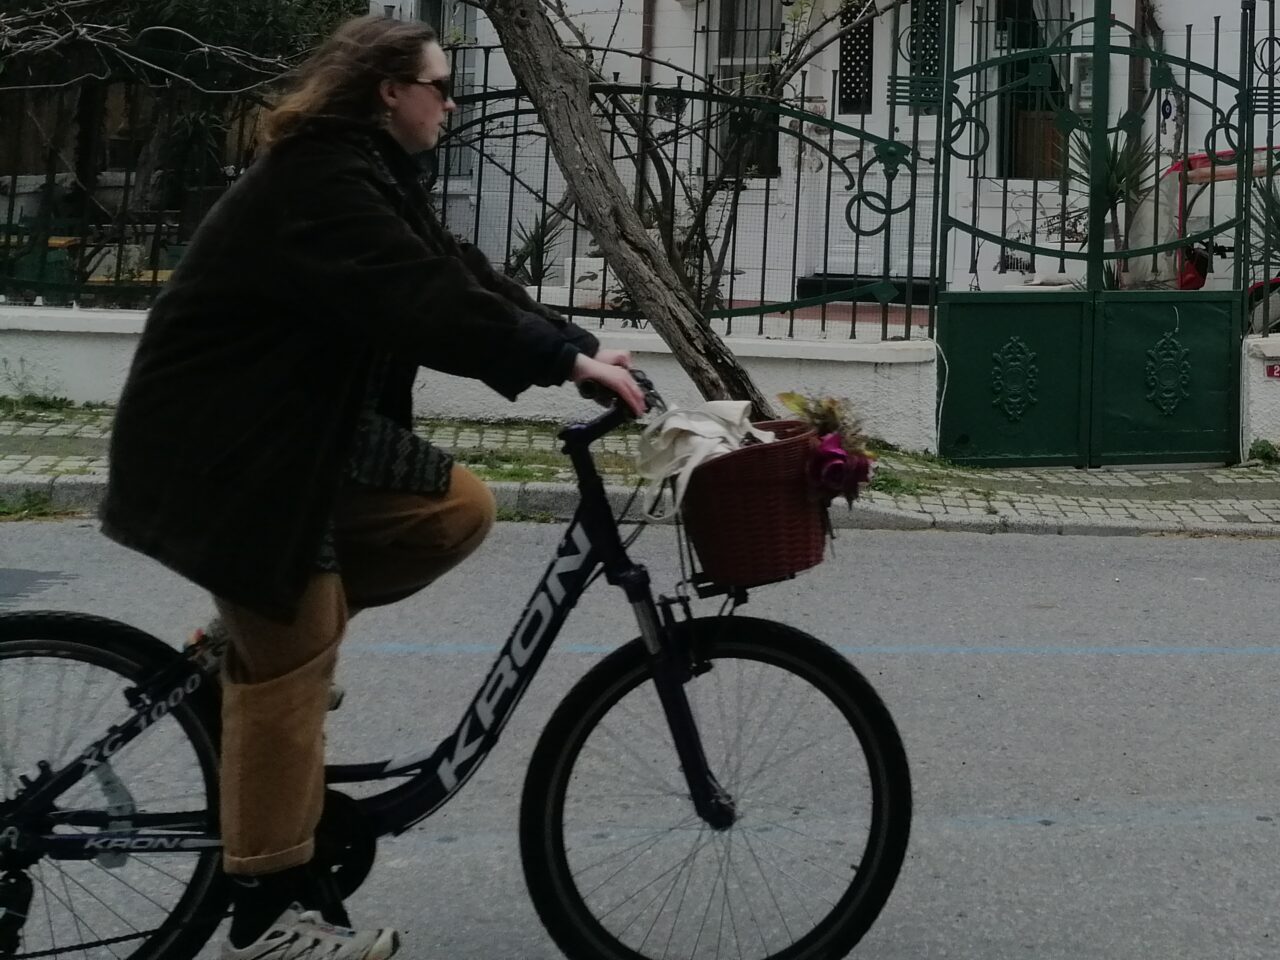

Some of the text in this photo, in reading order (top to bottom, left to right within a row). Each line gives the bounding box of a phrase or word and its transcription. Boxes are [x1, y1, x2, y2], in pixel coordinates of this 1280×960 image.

[1273, 365, 1280, 376] 2
[437, 522, 593, 793] KRON
[135, 673, 201, 728] 1000
[84, 838, 181, 849] KRON
